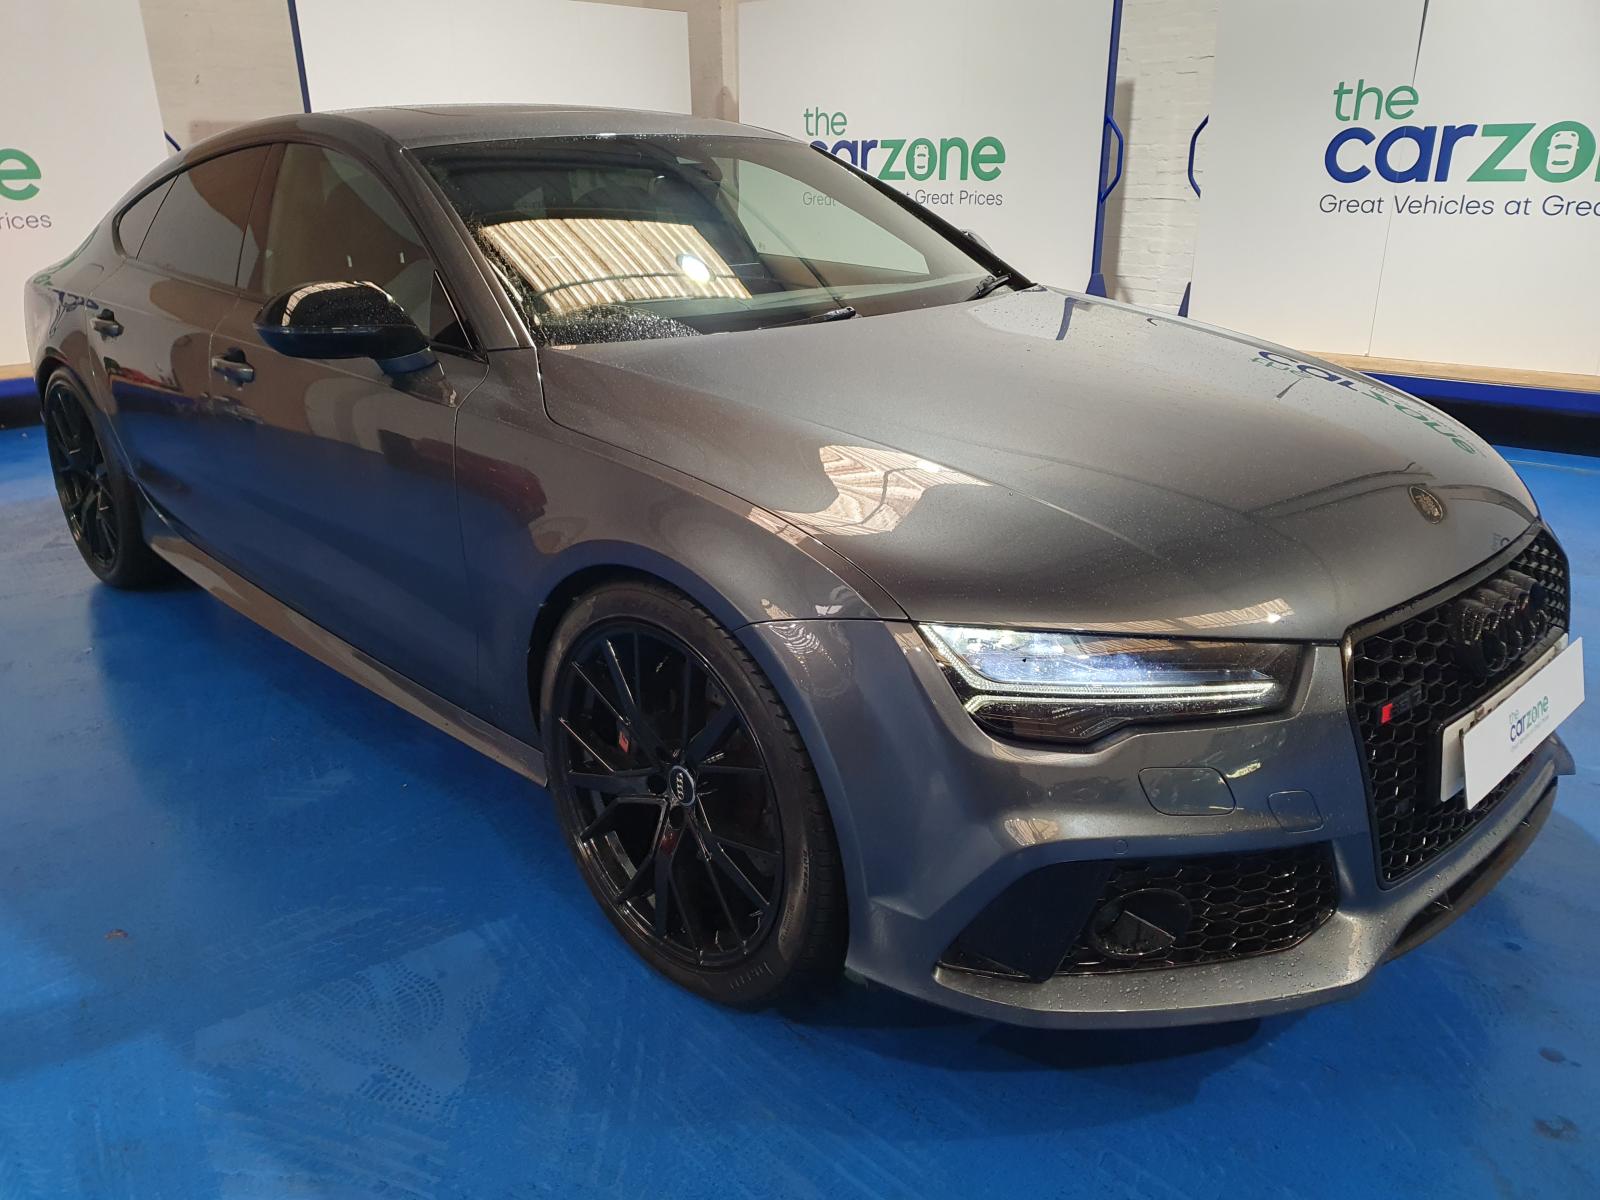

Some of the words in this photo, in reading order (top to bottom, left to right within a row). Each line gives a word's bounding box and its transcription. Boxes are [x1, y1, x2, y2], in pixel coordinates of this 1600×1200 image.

[1333, 79, 1419, 121] the
[804, 107, 847, 136] the
[1325, 121, 1600, 183] carzo
[915, 189, 954, 206] Great
[959, 190, 1003, 206] Prices
[1319, 194, 1384, 214] Great
[1394, 194, 1494, 216] Vehicles
[1504, 196, 1532, 216] at
[1510, 695, 1549, 742] carzone
